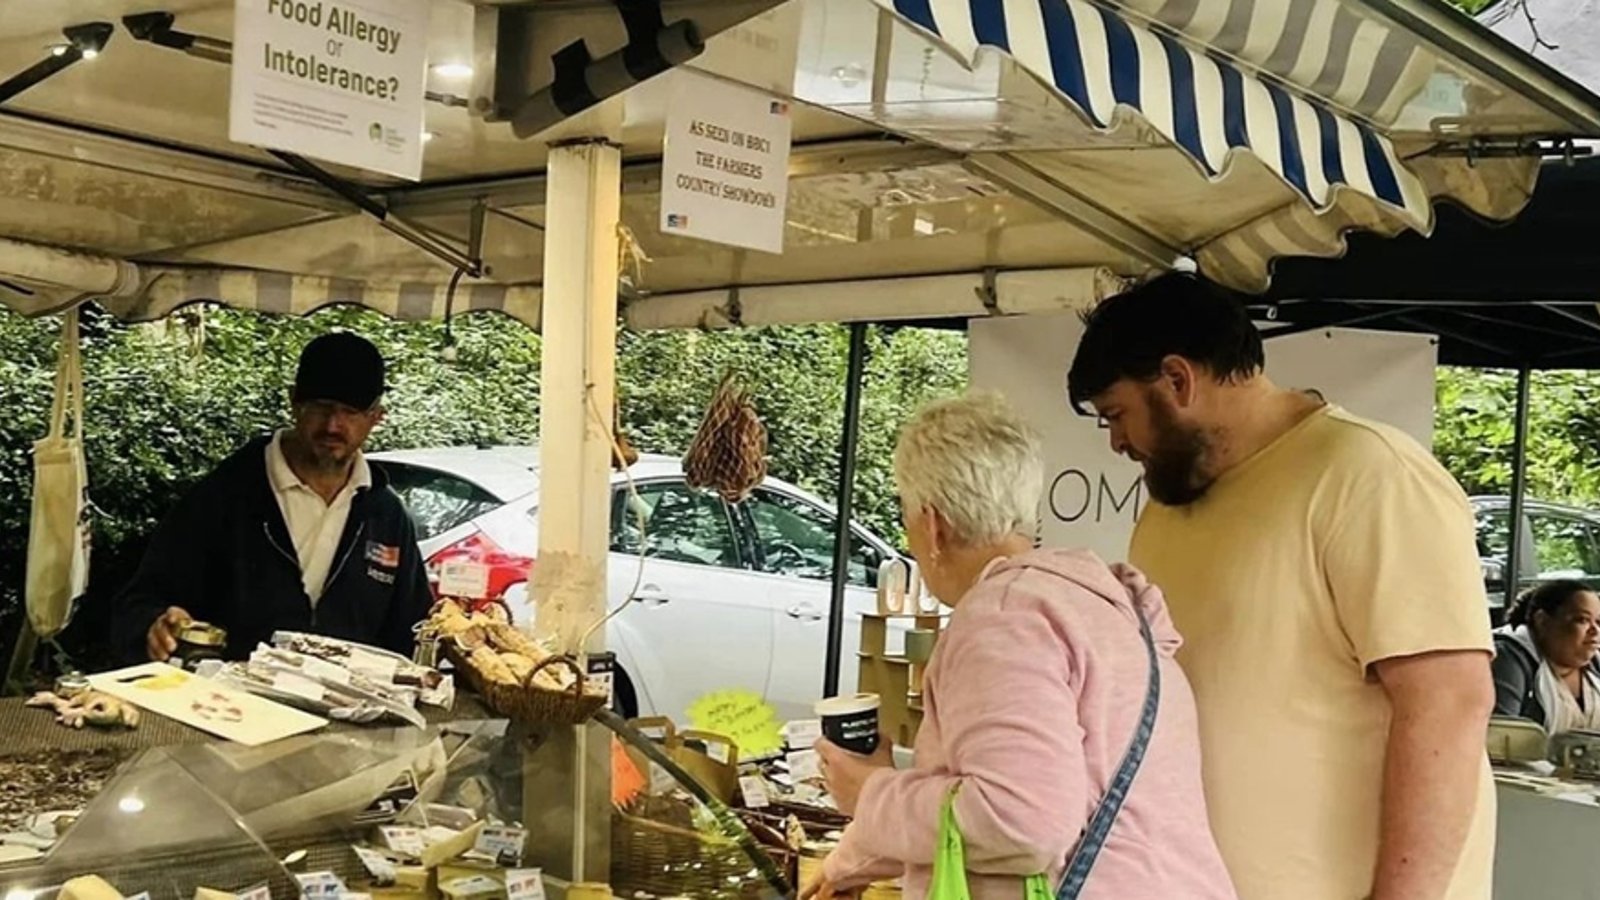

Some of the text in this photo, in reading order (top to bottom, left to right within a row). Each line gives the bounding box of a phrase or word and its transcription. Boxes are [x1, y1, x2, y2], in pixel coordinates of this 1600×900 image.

[326, 7, 402, 54] Allergy
[326, 39, 344, 58] or
[264, 42, 399, 101] Intolerance?
[689, 120, 704, 136] AS
[705, 124, 729, 144] SEEN
[732, 132, 744, 146] ON
[696, 151, 762, 179] THE FARMERS
[676, 173, 775, 208] COUNTRY SHOWDOWN
